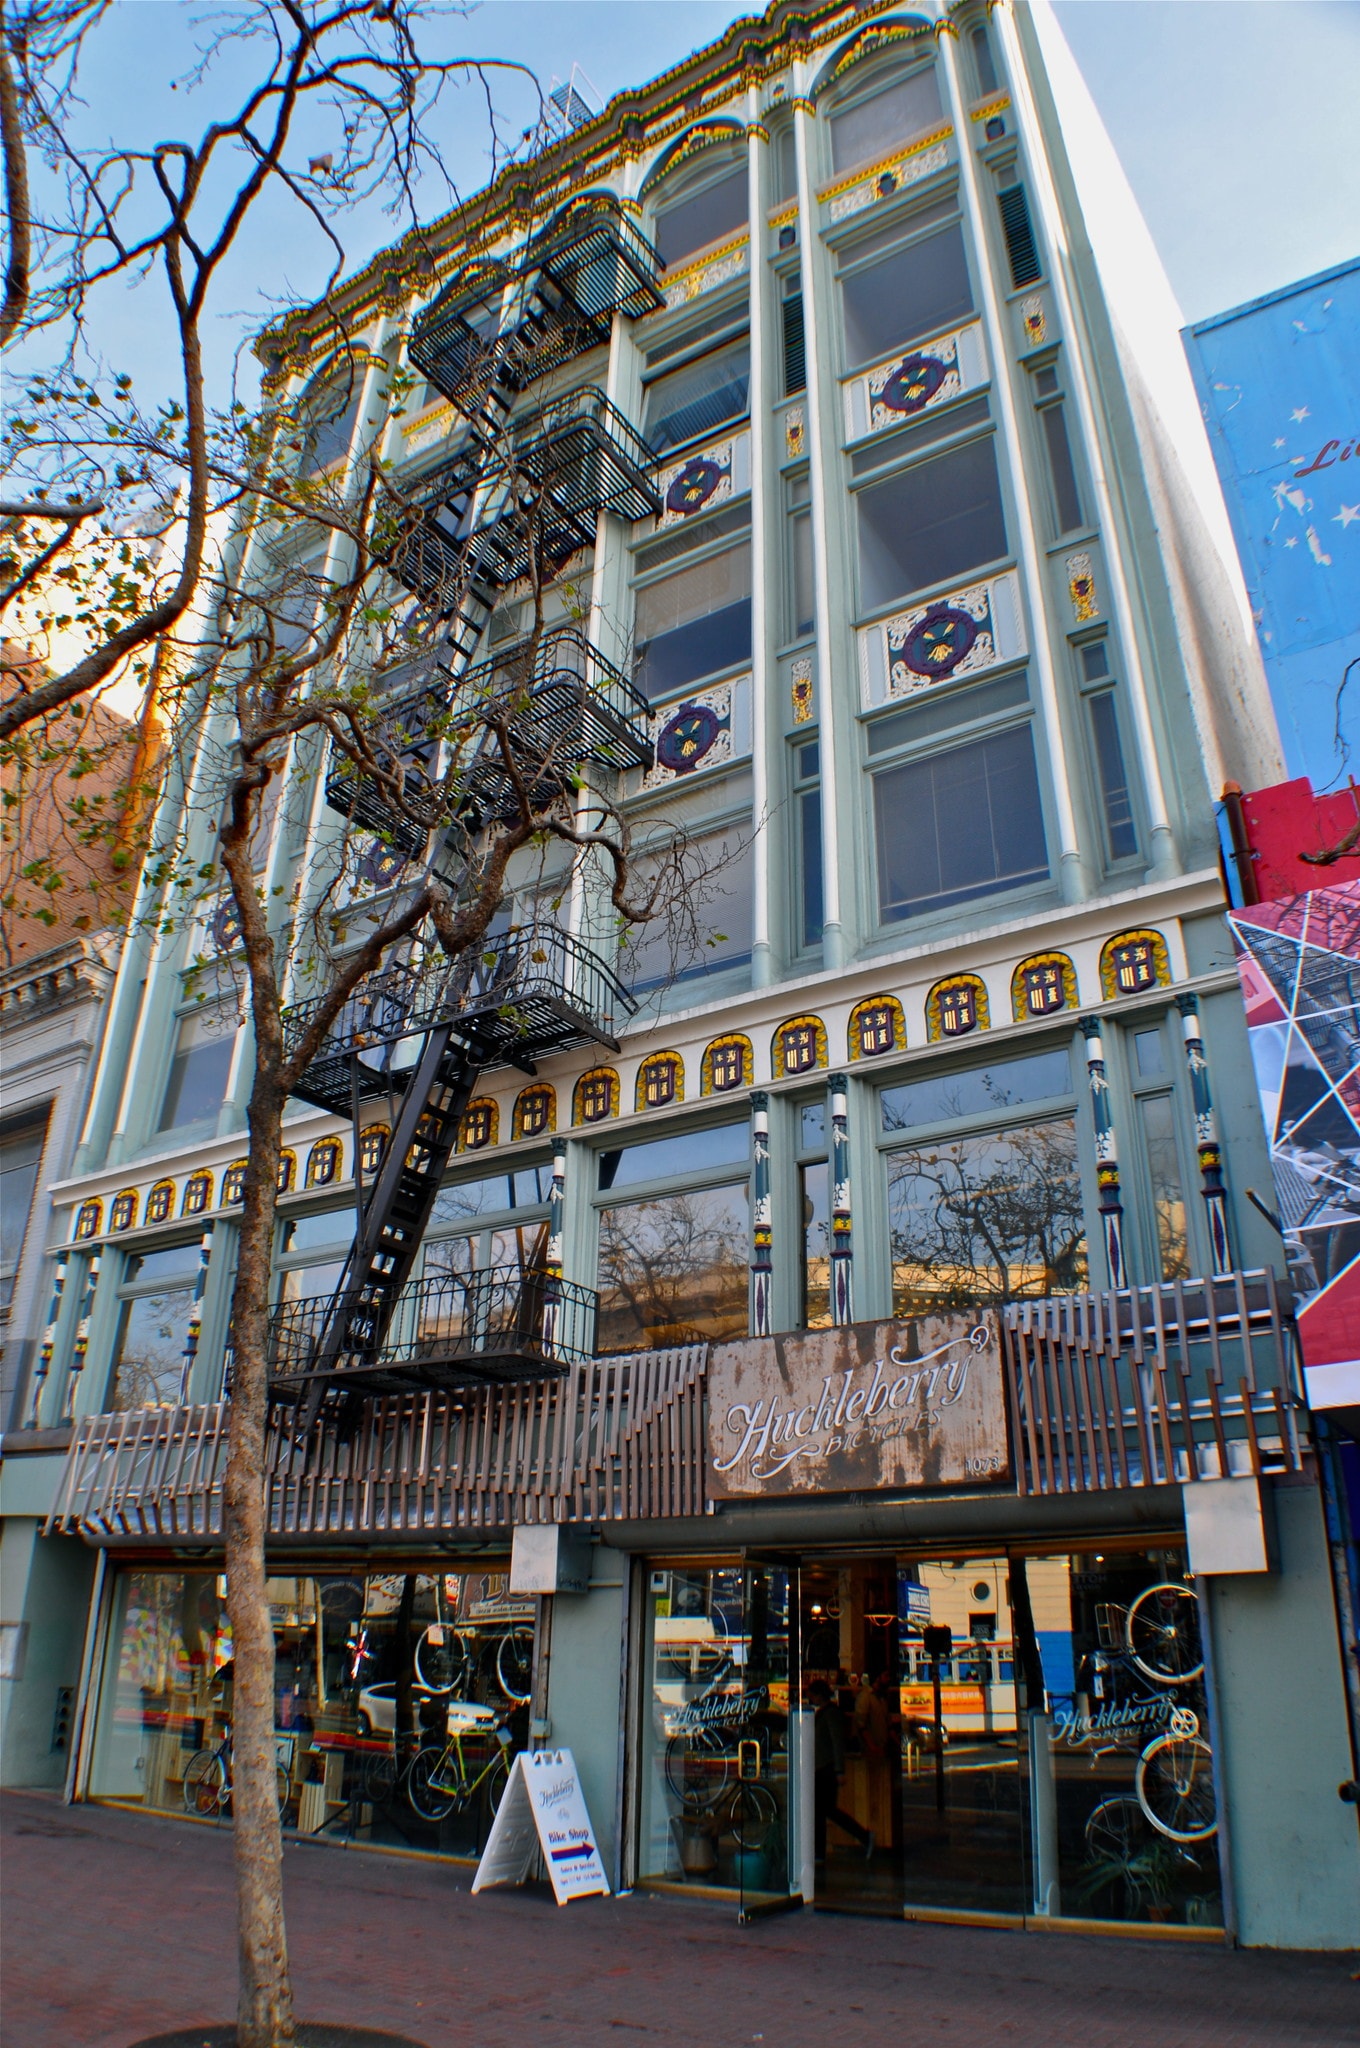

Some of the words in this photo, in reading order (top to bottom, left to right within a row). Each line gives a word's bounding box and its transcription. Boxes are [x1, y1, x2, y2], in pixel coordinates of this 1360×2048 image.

[713, 1328, 989, 1478] Huckleberry
[824, 1408, 943, 1456] BICYCLES
[966, 1457, 999, 1473] 1073
[672, 1686, 766, 1725] Huckleberry
[1049, 1689, 1177, 1746] Huckleberry
[549, 1831, 566, 1843] Bike
[569, 1828, 589, 1841] Shop
